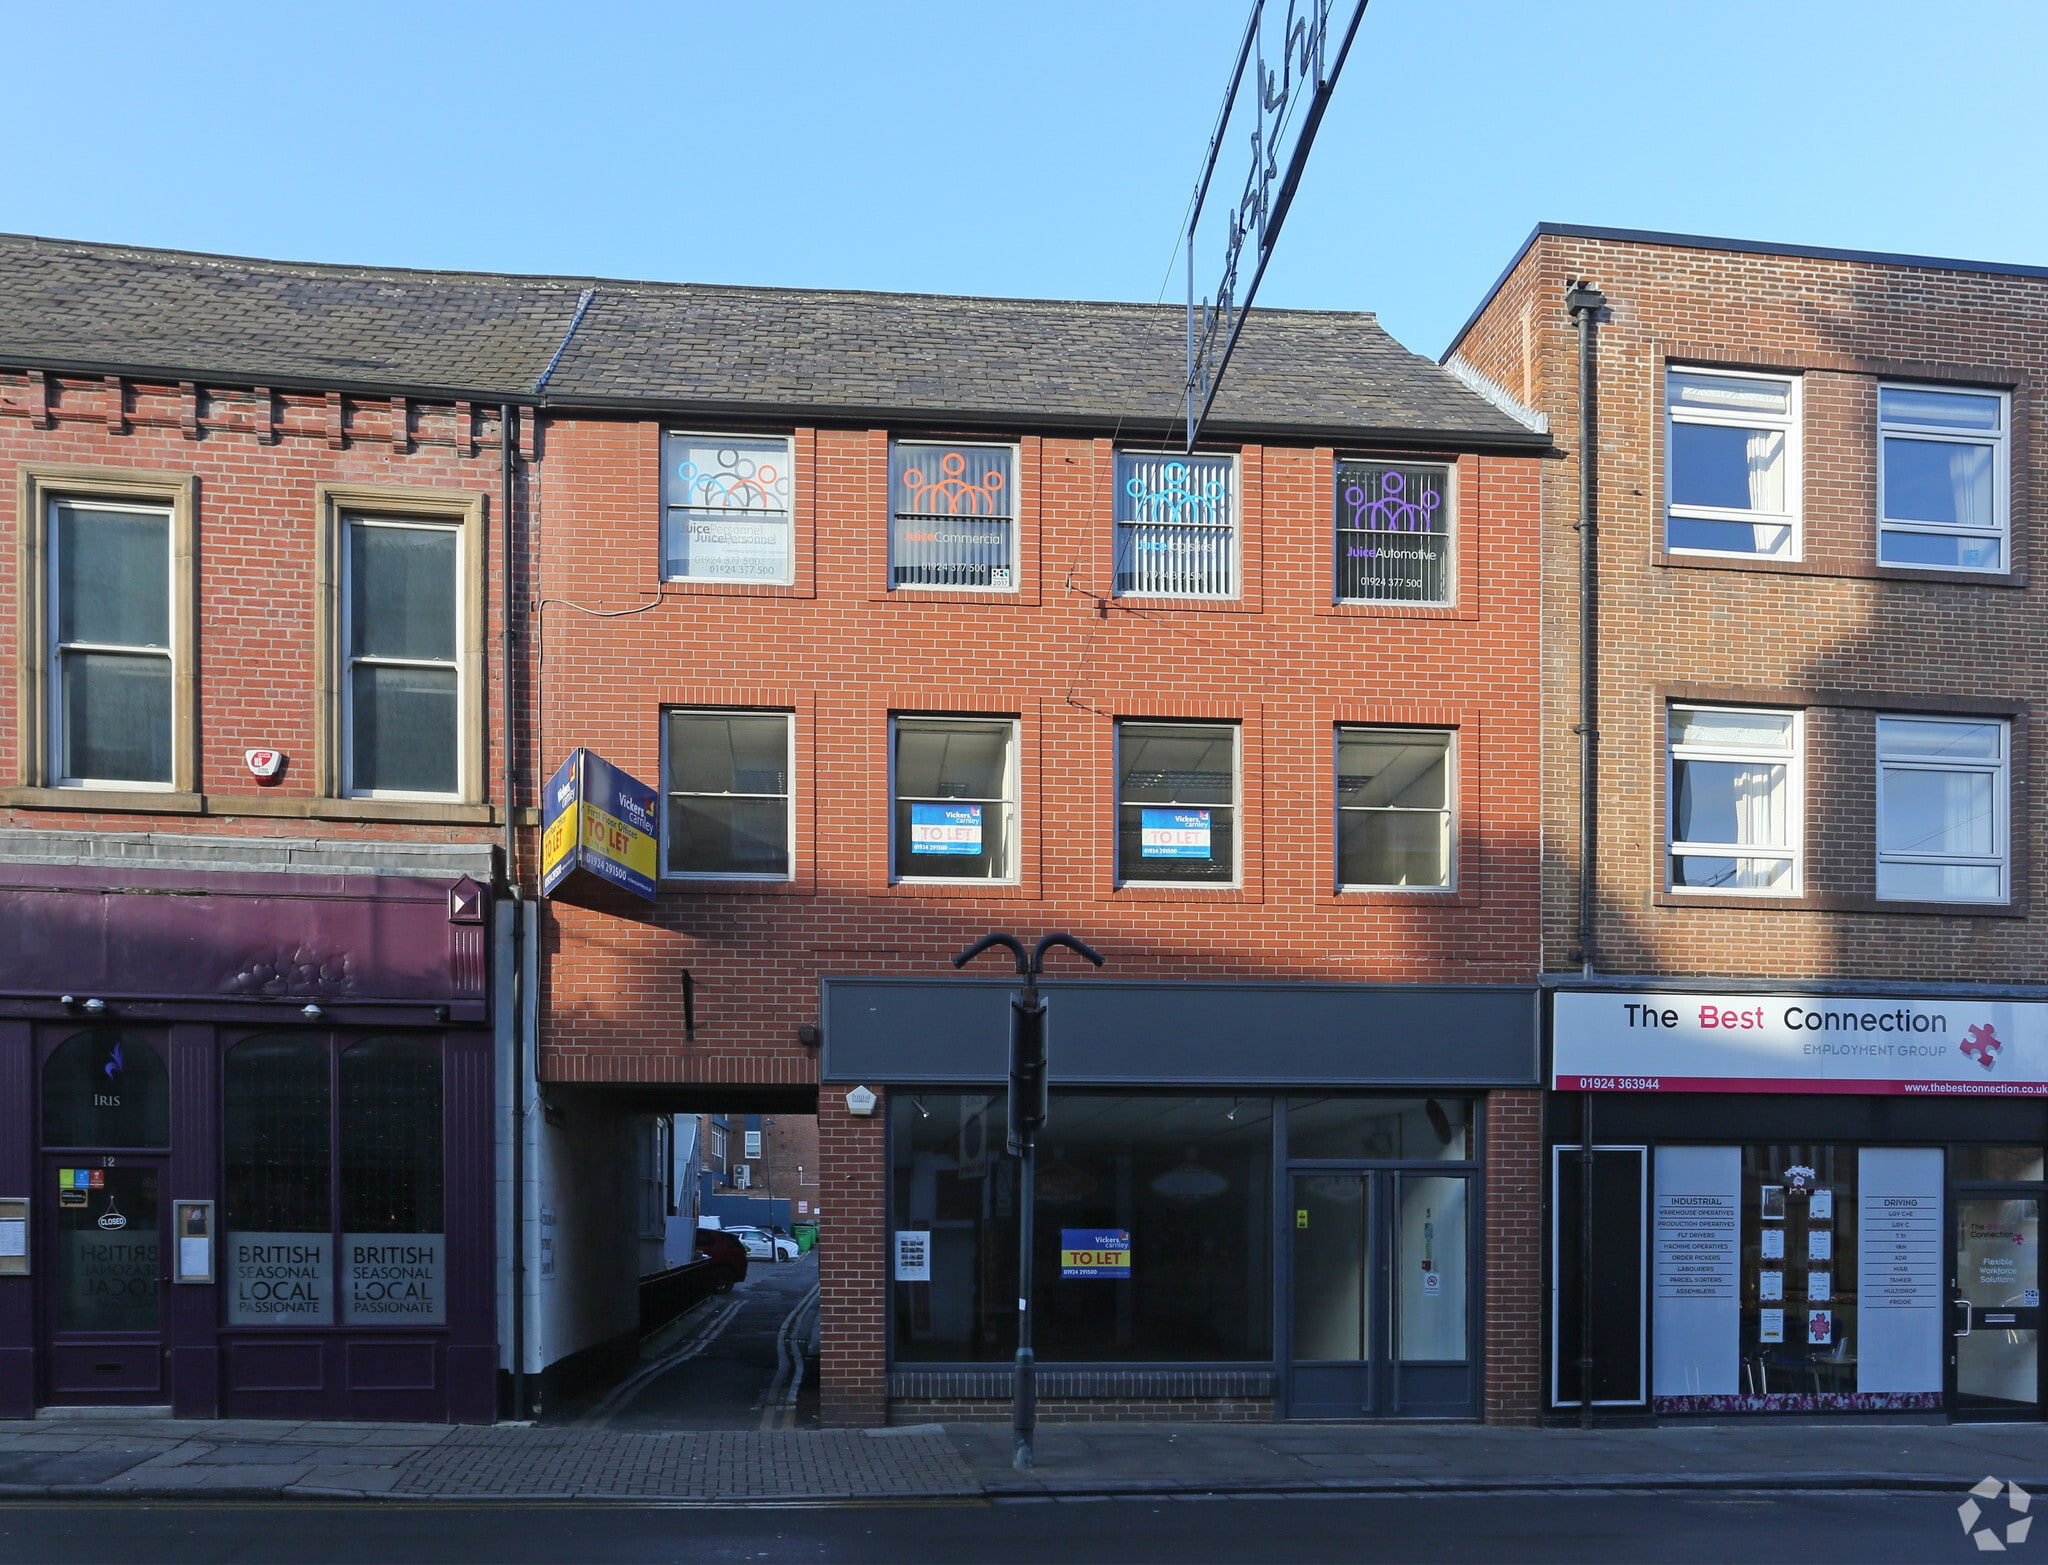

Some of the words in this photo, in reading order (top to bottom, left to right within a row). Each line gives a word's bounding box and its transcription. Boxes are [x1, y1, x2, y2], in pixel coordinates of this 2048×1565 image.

[905, 530, 1003, 545] JuiceCommercial
[1347, 545, 1437, 561] JuiceAutomotive
[922, 563, 948, 571] 01924
[950, 564, 966, 572] 377
[969, 564, 986, 573] 500
[1360, 576, 1387, 587] 01924
[1388, 577, 1405, 587] 377
[1406, 578, 1422, 588] 500
[619, 791, 645, 817] Vickers
[945, 811, 971, 819] Vickers
[955, 817, 980, 825] carnley
[1175, 815, 1201, 824] Vickers
[587, 805, 602, 820] First
[602, 813, 617, 829] Floor
[618, 822, 638, 840] Offices
[629, 812, 654, 835] carnley
[553, 828, 563, 852] LET
[587, 816, 606, 842] TO
[609, 828, 630, 855] LET
[920, 827, 943, 841] TO
[947, 828, 973, 842] LET
[1150, 831, 1173, 844] TO
[1176, 832, 1201, 845] LET
[586, 853, 605, 870] 01924
[605, 862, 627, 881] 291500
[1624, 1004, 1679, 1029] The
[1699, 1004, 1764, 1030] Best
[1784, 1007, 1948, 1033] Connection
[1803, 1044, 1895, 1056] EMPLOYMENT
[1898, 1045, 1948, 1057] GROUP
[1580, 1077, 1616, 1089] 01924
[1618, 1078, 1660, 1090] 363944
[1904, 1082, 2048, 1094] www.thebestconnection.co.uk
[102, 1156, 115, 1167] 12
[101, 1217, 125, 1227] CLOSED
[239, 1246, 320, 1264] BRITISH
[353, 1247, 434, 1265] BRITISH
[1070, 1252, 1093, 1265] TO
[1097, 1252, 1122, 1265] LET
[239, 1266, 319, 1280] SEASONAL
[353, 1267, 433, 1280] SEASONAL
[1979, 1267, 2017, 1275] Workforce
[240, 1281, 319, 1302] LOCAL
[354, 1282, 433, 1302] LOCAL
[239, 1301, 320, 1314] PASSIONATE
[354, 1302, 433, 1314] PASSIONATE
